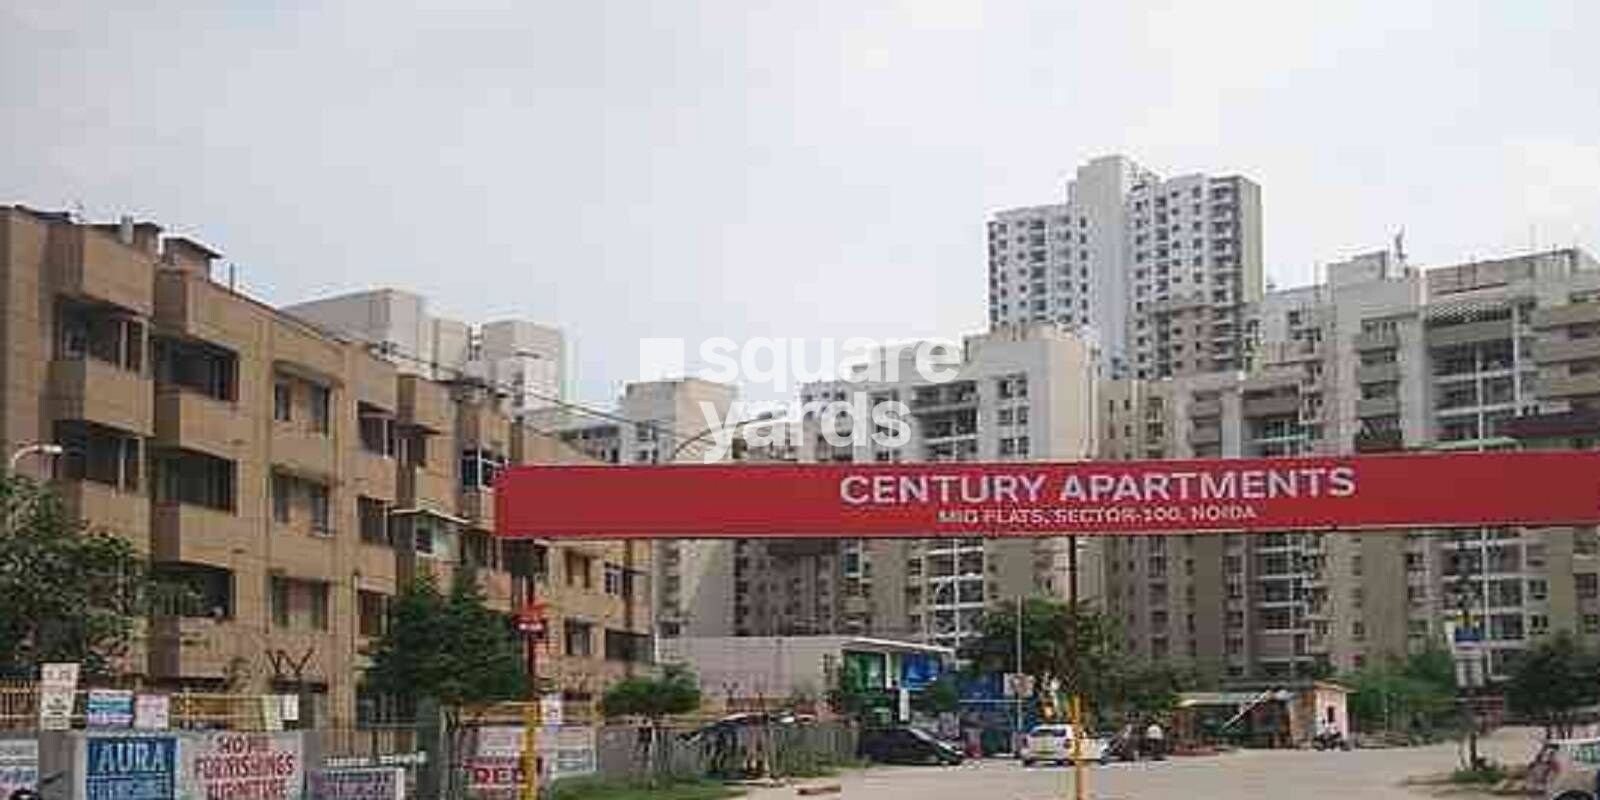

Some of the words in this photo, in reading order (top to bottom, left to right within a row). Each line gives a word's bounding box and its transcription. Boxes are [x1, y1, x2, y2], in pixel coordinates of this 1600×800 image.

[839, 473, 1047, 504] CENTURY
[1060, 466, 1355, 502] APARTMENTS
[1191, 503, 1257, 520] NOIDA
[99, 740, 167, 773] AURA
